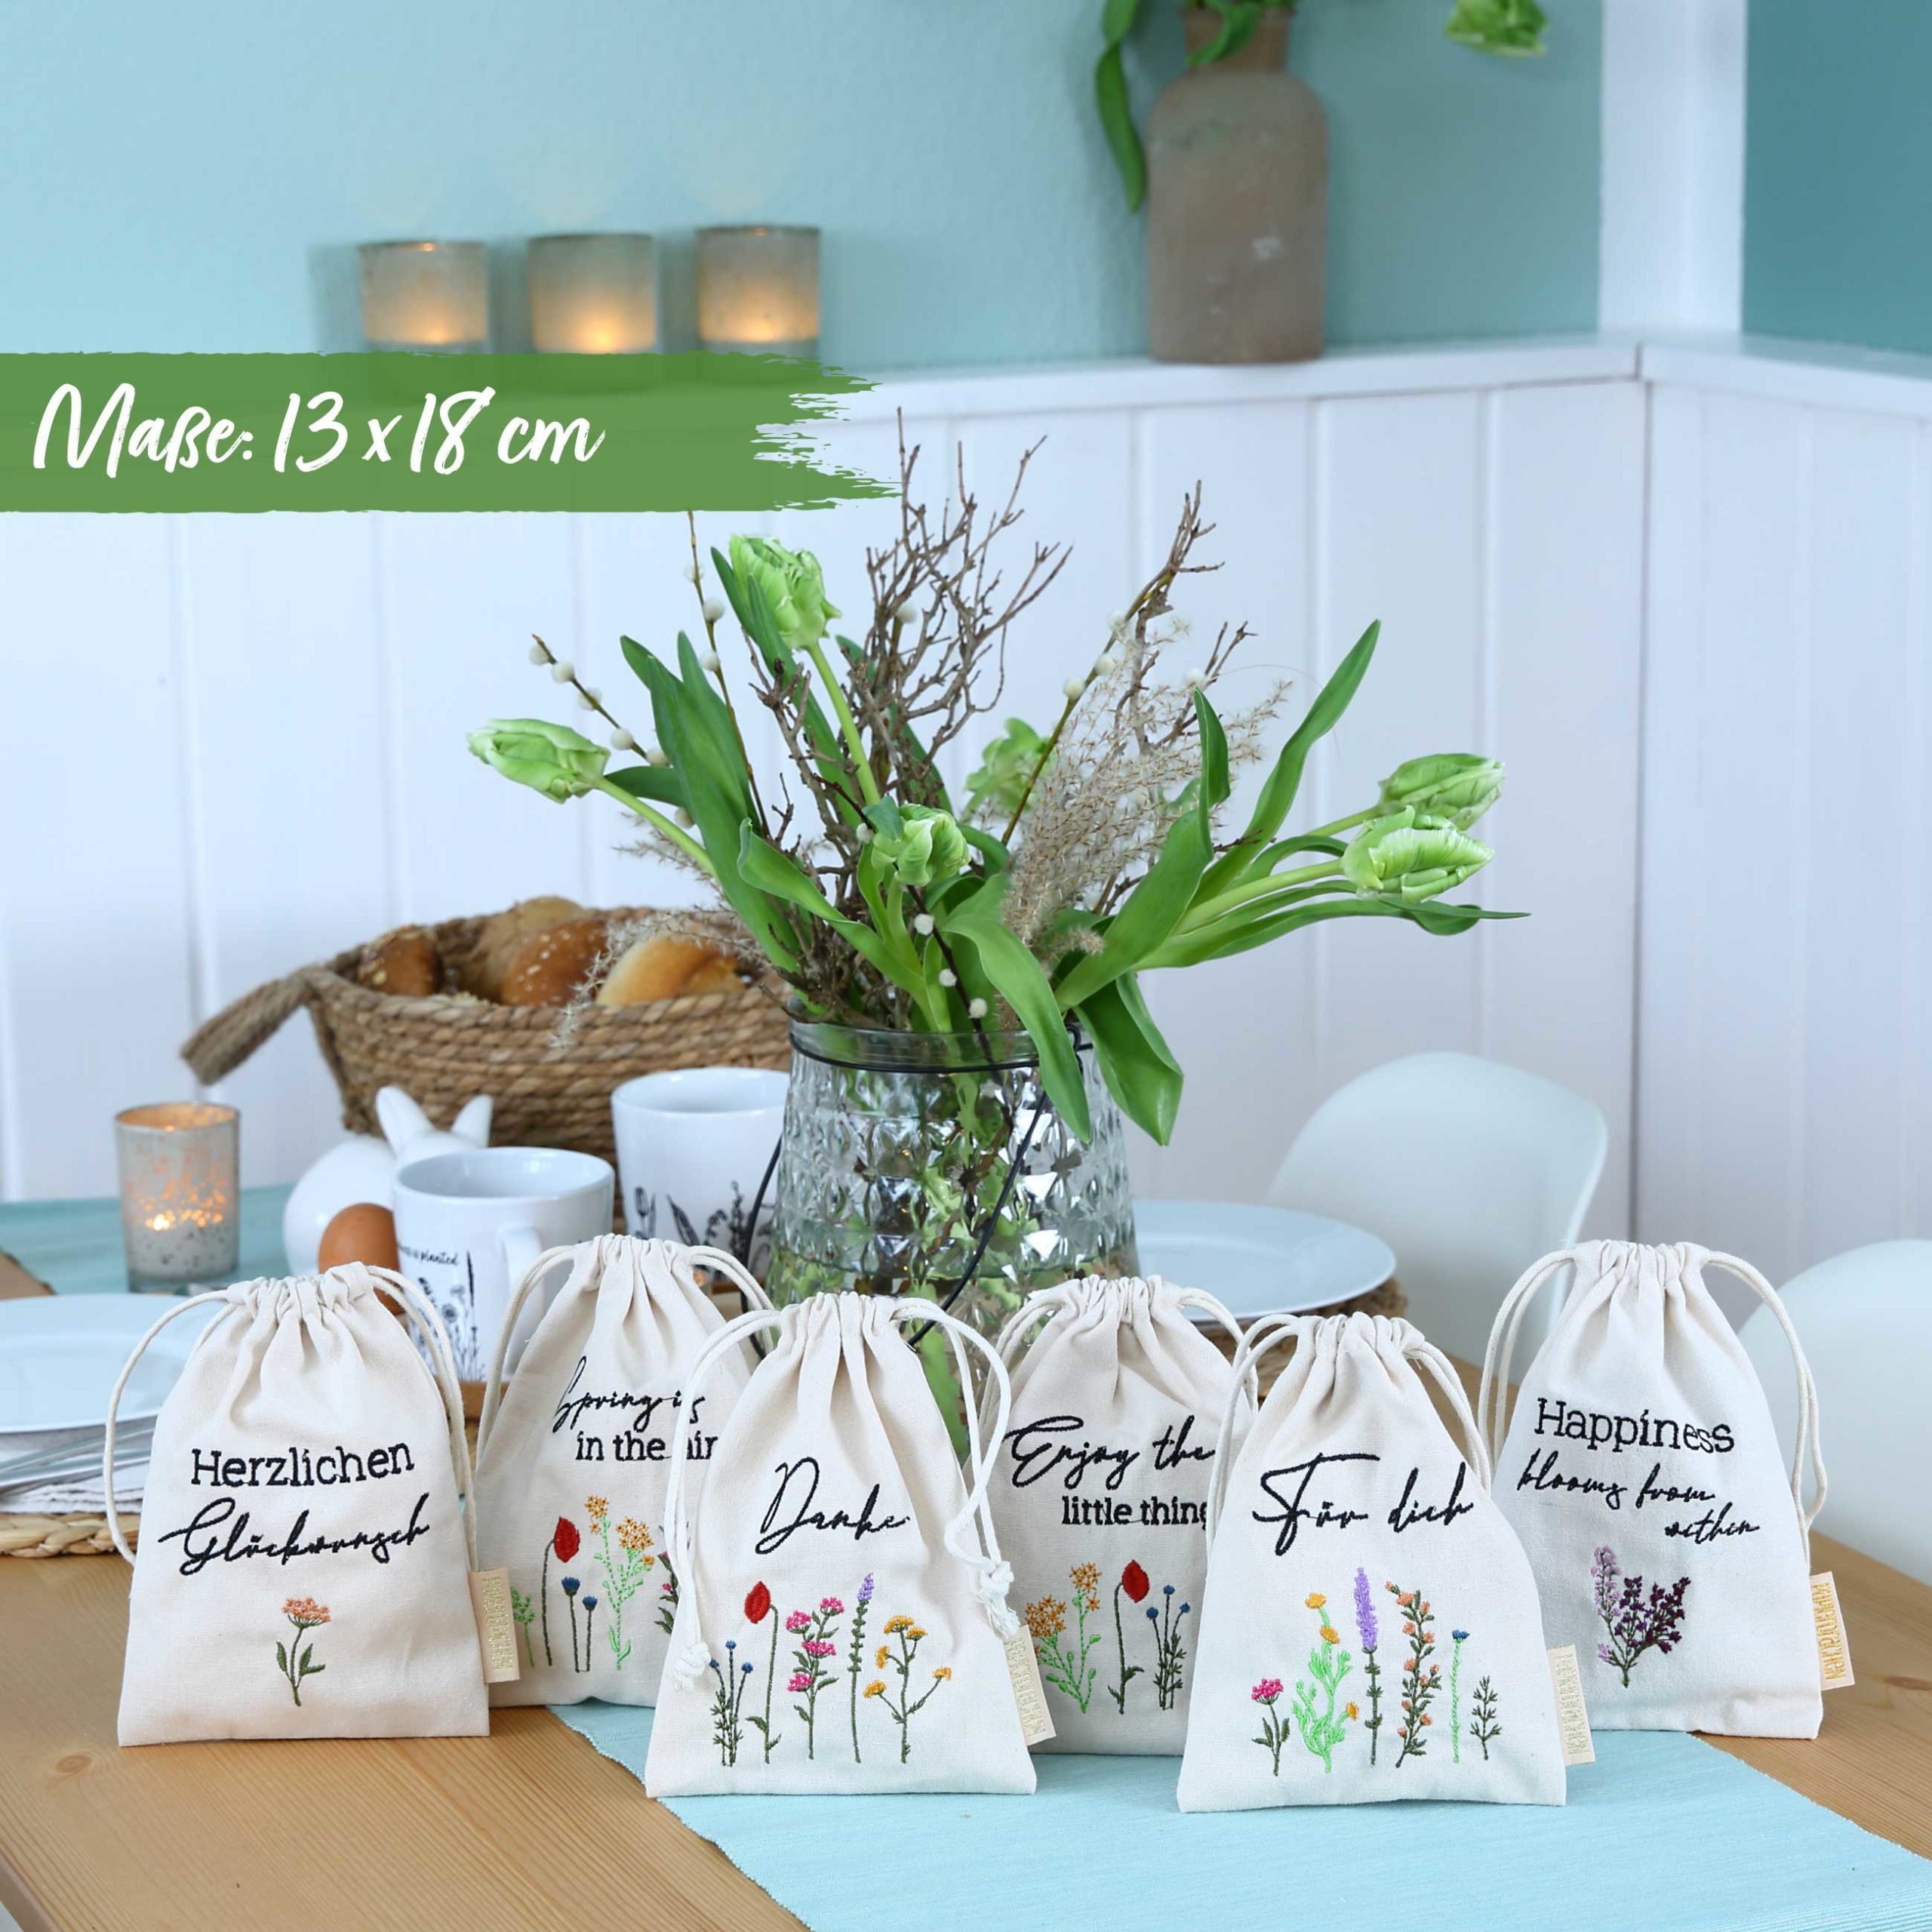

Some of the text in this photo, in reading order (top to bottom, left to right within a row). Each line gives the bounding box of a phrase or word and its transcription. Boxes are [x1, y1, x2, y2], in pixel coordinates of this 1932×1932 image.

[575, 1430, 605, 1461] in
[612, 1432, 666, 1462] the
[1001, 1414, 1216, 1491] Enjoy the
[1532, 1397, 1735, 1456] Happiness
[191, 1442, 415, 1488] Herzlichen
[1635, 1463, 1715, 1509] from
[755, 1457, 910, 1555] Danke
[1061, 1495, 1208, 1531] little thin
[1252, 1452, 1474, 1556] Für dich
[1664, 1499, 1760, 1545] within
[158, 1493, 430, 1576] Glückwunsch
